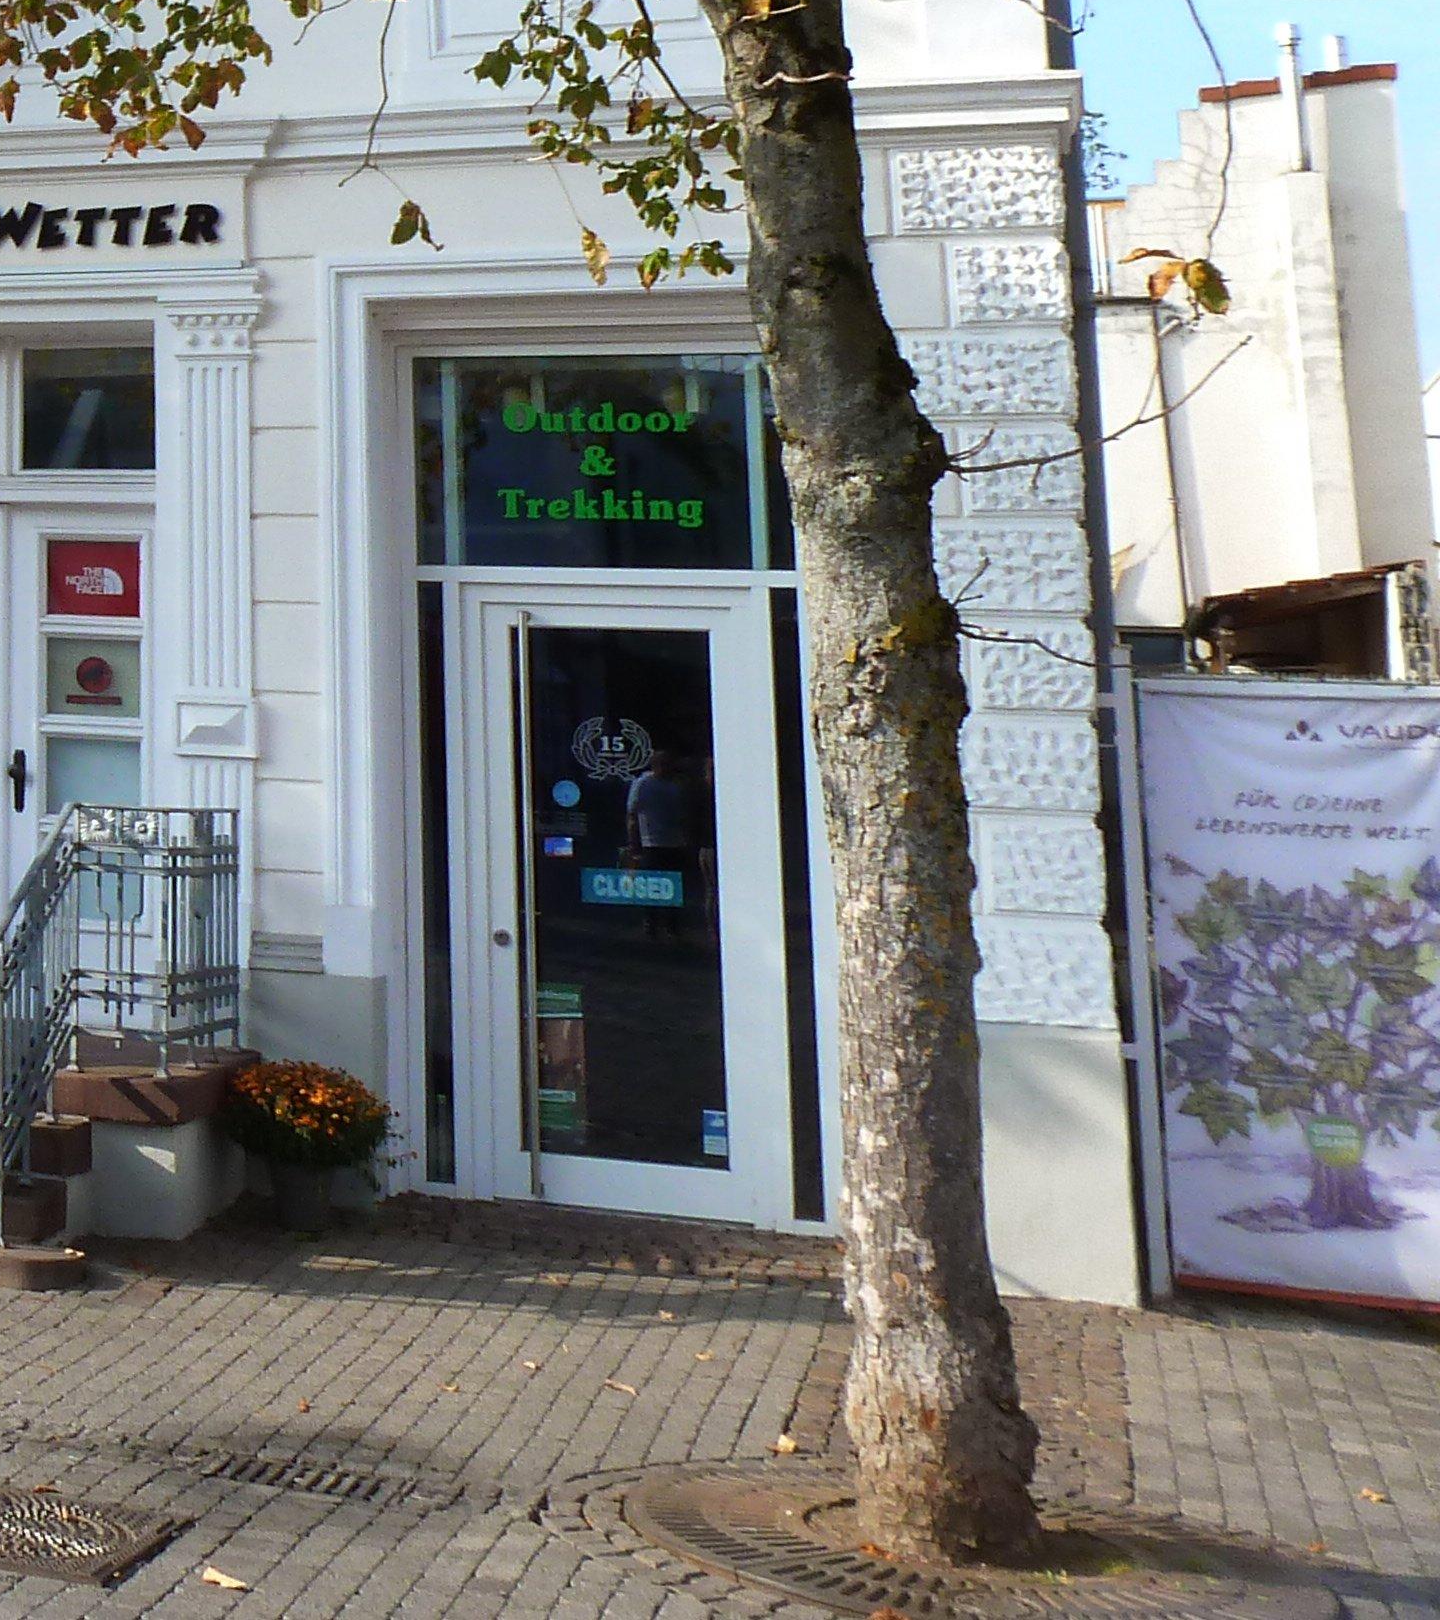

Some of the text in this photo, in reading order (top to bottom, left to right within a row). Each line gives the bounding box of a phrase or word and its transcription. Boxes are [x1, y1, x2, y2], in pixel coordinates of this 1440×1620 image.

[502, 401, 692, 432] Outdoor
[579, 445, 616, 476] &
[497, 488, 703, 528] Trekking
[600, 735, 625, 752] 15
[592, 873, 675, 901] CLOSED
